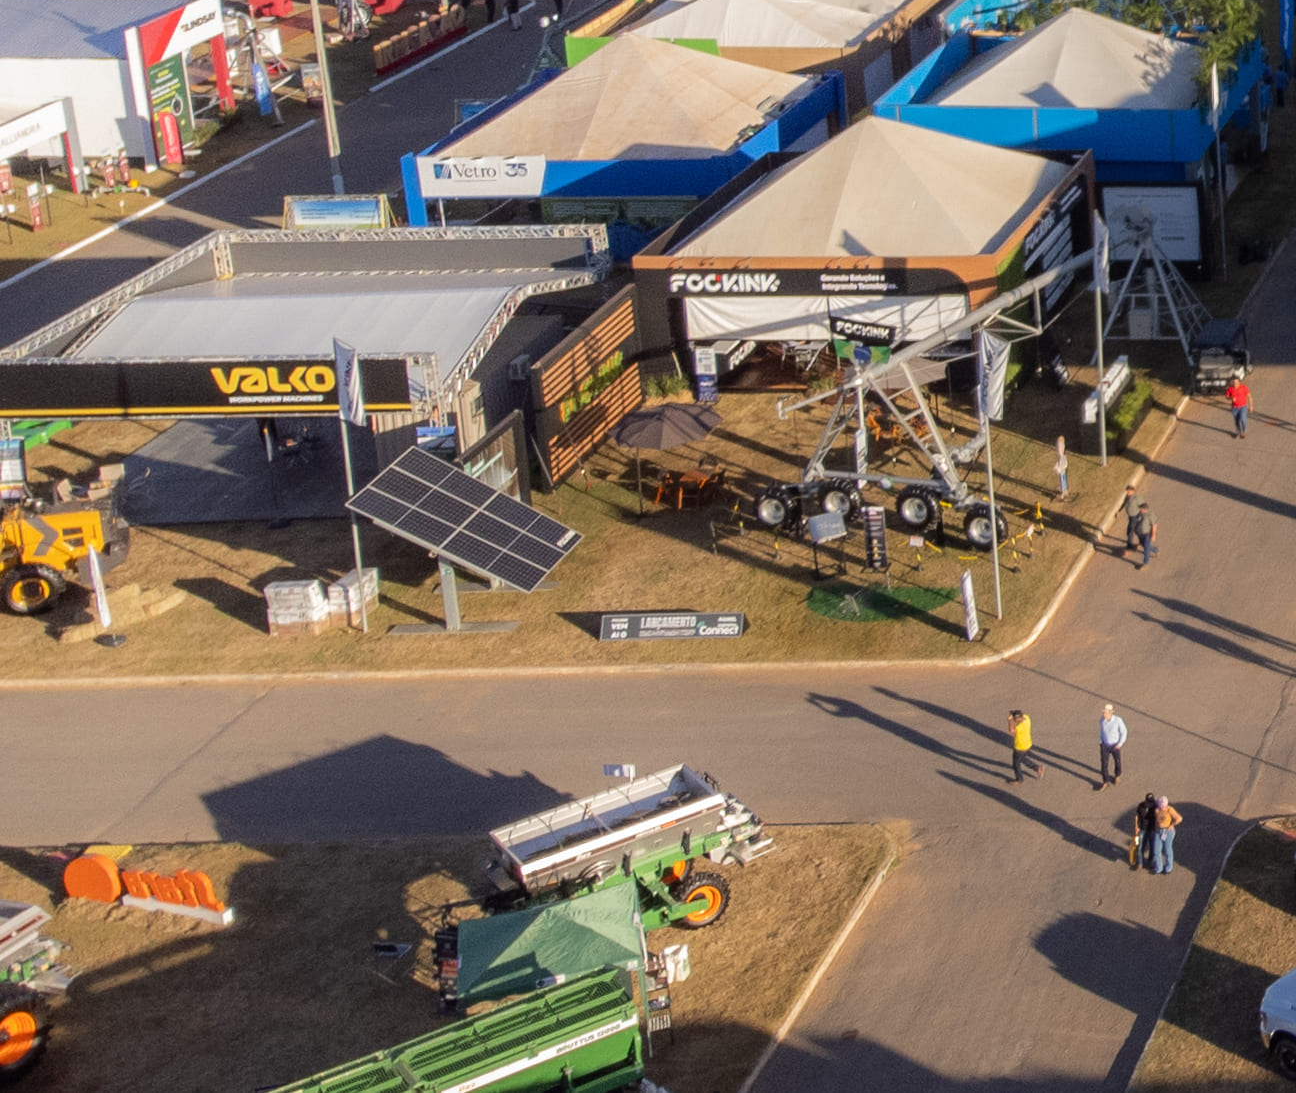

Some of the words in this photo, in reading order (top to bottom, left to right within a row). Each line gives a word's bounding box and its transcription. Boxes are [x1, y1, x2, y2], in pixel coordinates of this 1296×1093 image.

[452, 164, 497, 179] Vetro
[504, 163, 528, 178] 35
[670, 273, 780, 294] FOCKINK
[836, 320, 890, 340] FOCKINK
[282, 395, 324, 403] MACHINES
[640, 615, 697, 631] LANÇAMENTO
[699, 625, 739, 636] Connect
